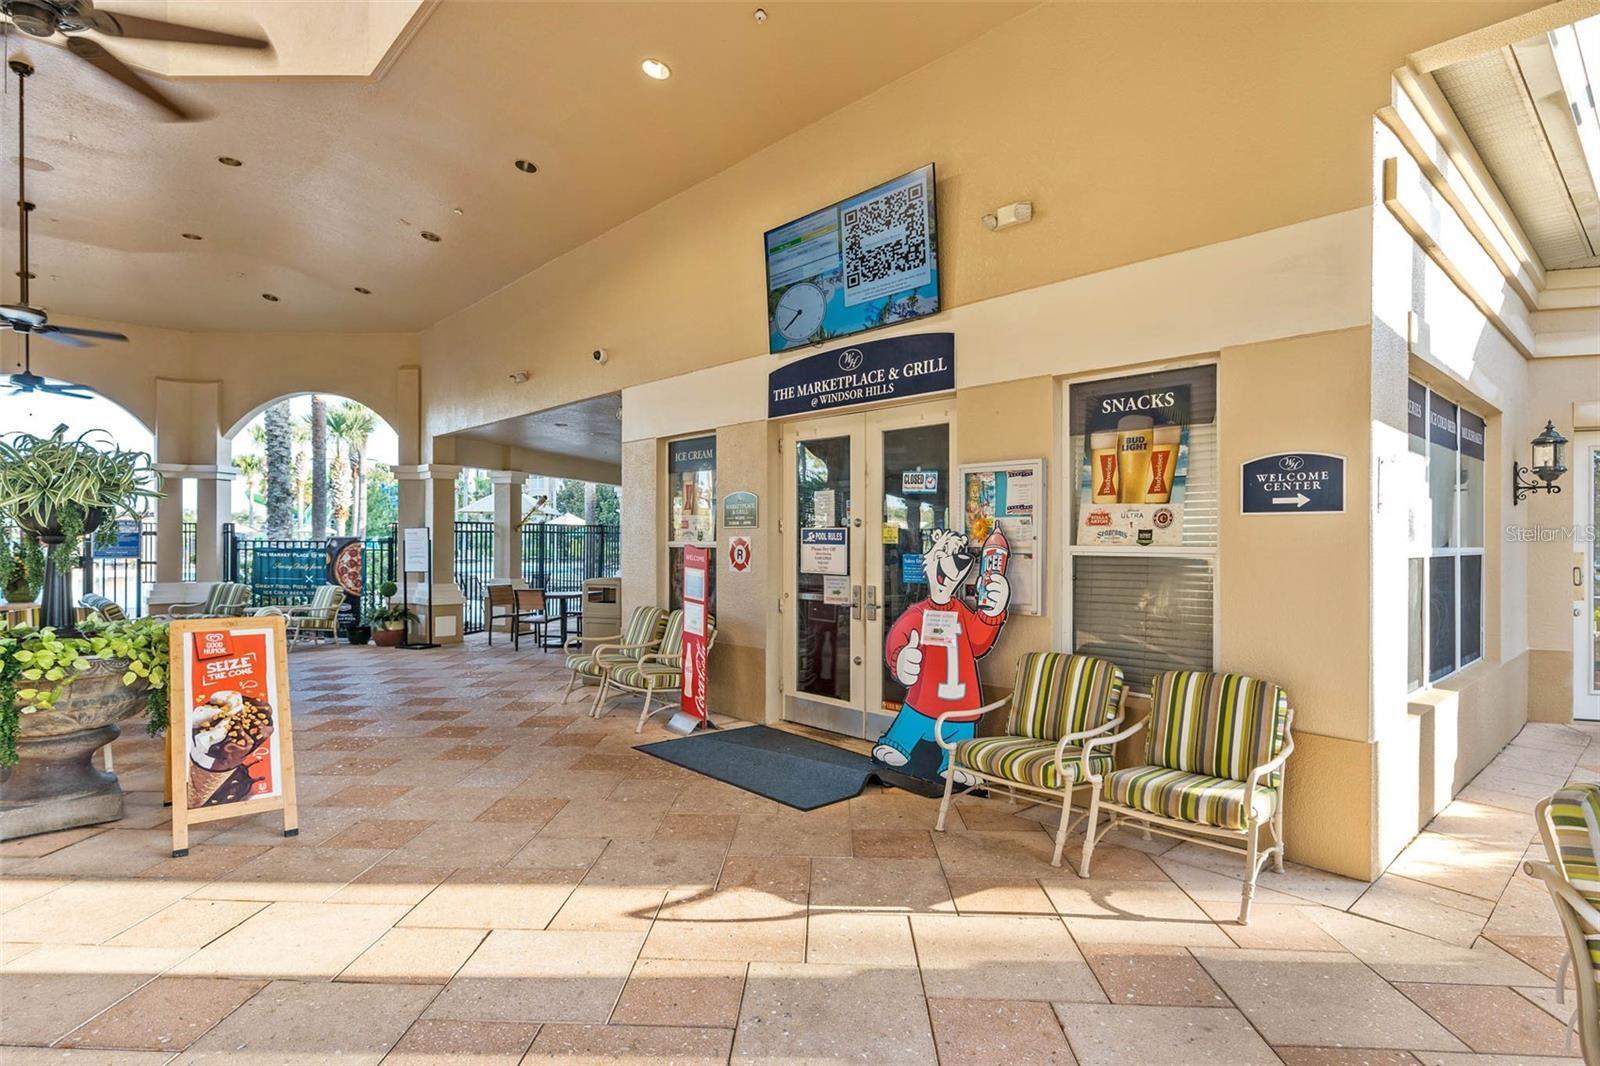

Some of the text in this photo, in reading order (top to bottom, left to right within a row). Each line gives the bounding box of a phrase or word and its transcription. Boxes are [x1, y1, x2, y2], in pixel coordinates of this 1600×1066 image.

[773, 357, 948, 402] THE MARKETPLACE & GRILL
[811, 383, 895, 407] @ WINDSOR HILLS
[1102, 392, 1175, 414] SNACKS
[1408, 400, 1422, 418] ERIES
[1438, 415, 1447, 431] COLD
[1448, 419, 1456, 434] BEER
[1126, 436, 1145, 444] BUD
[1122, 443, 1147, 451] LIGHT
[675, 449, 713, 462] ICE CREAM
[904, 474, 924, 485] CLOSED
[1256, 471, 1329, 483] WELCOME
[1263, 481, 1321, 492] CENTER
[815, 532, 843, 541] POOL RULES
[736, 549, 743, 560] R
[206, 657, 252, 673] SEIZE
[207, 668, 254, 680] THE CONE
